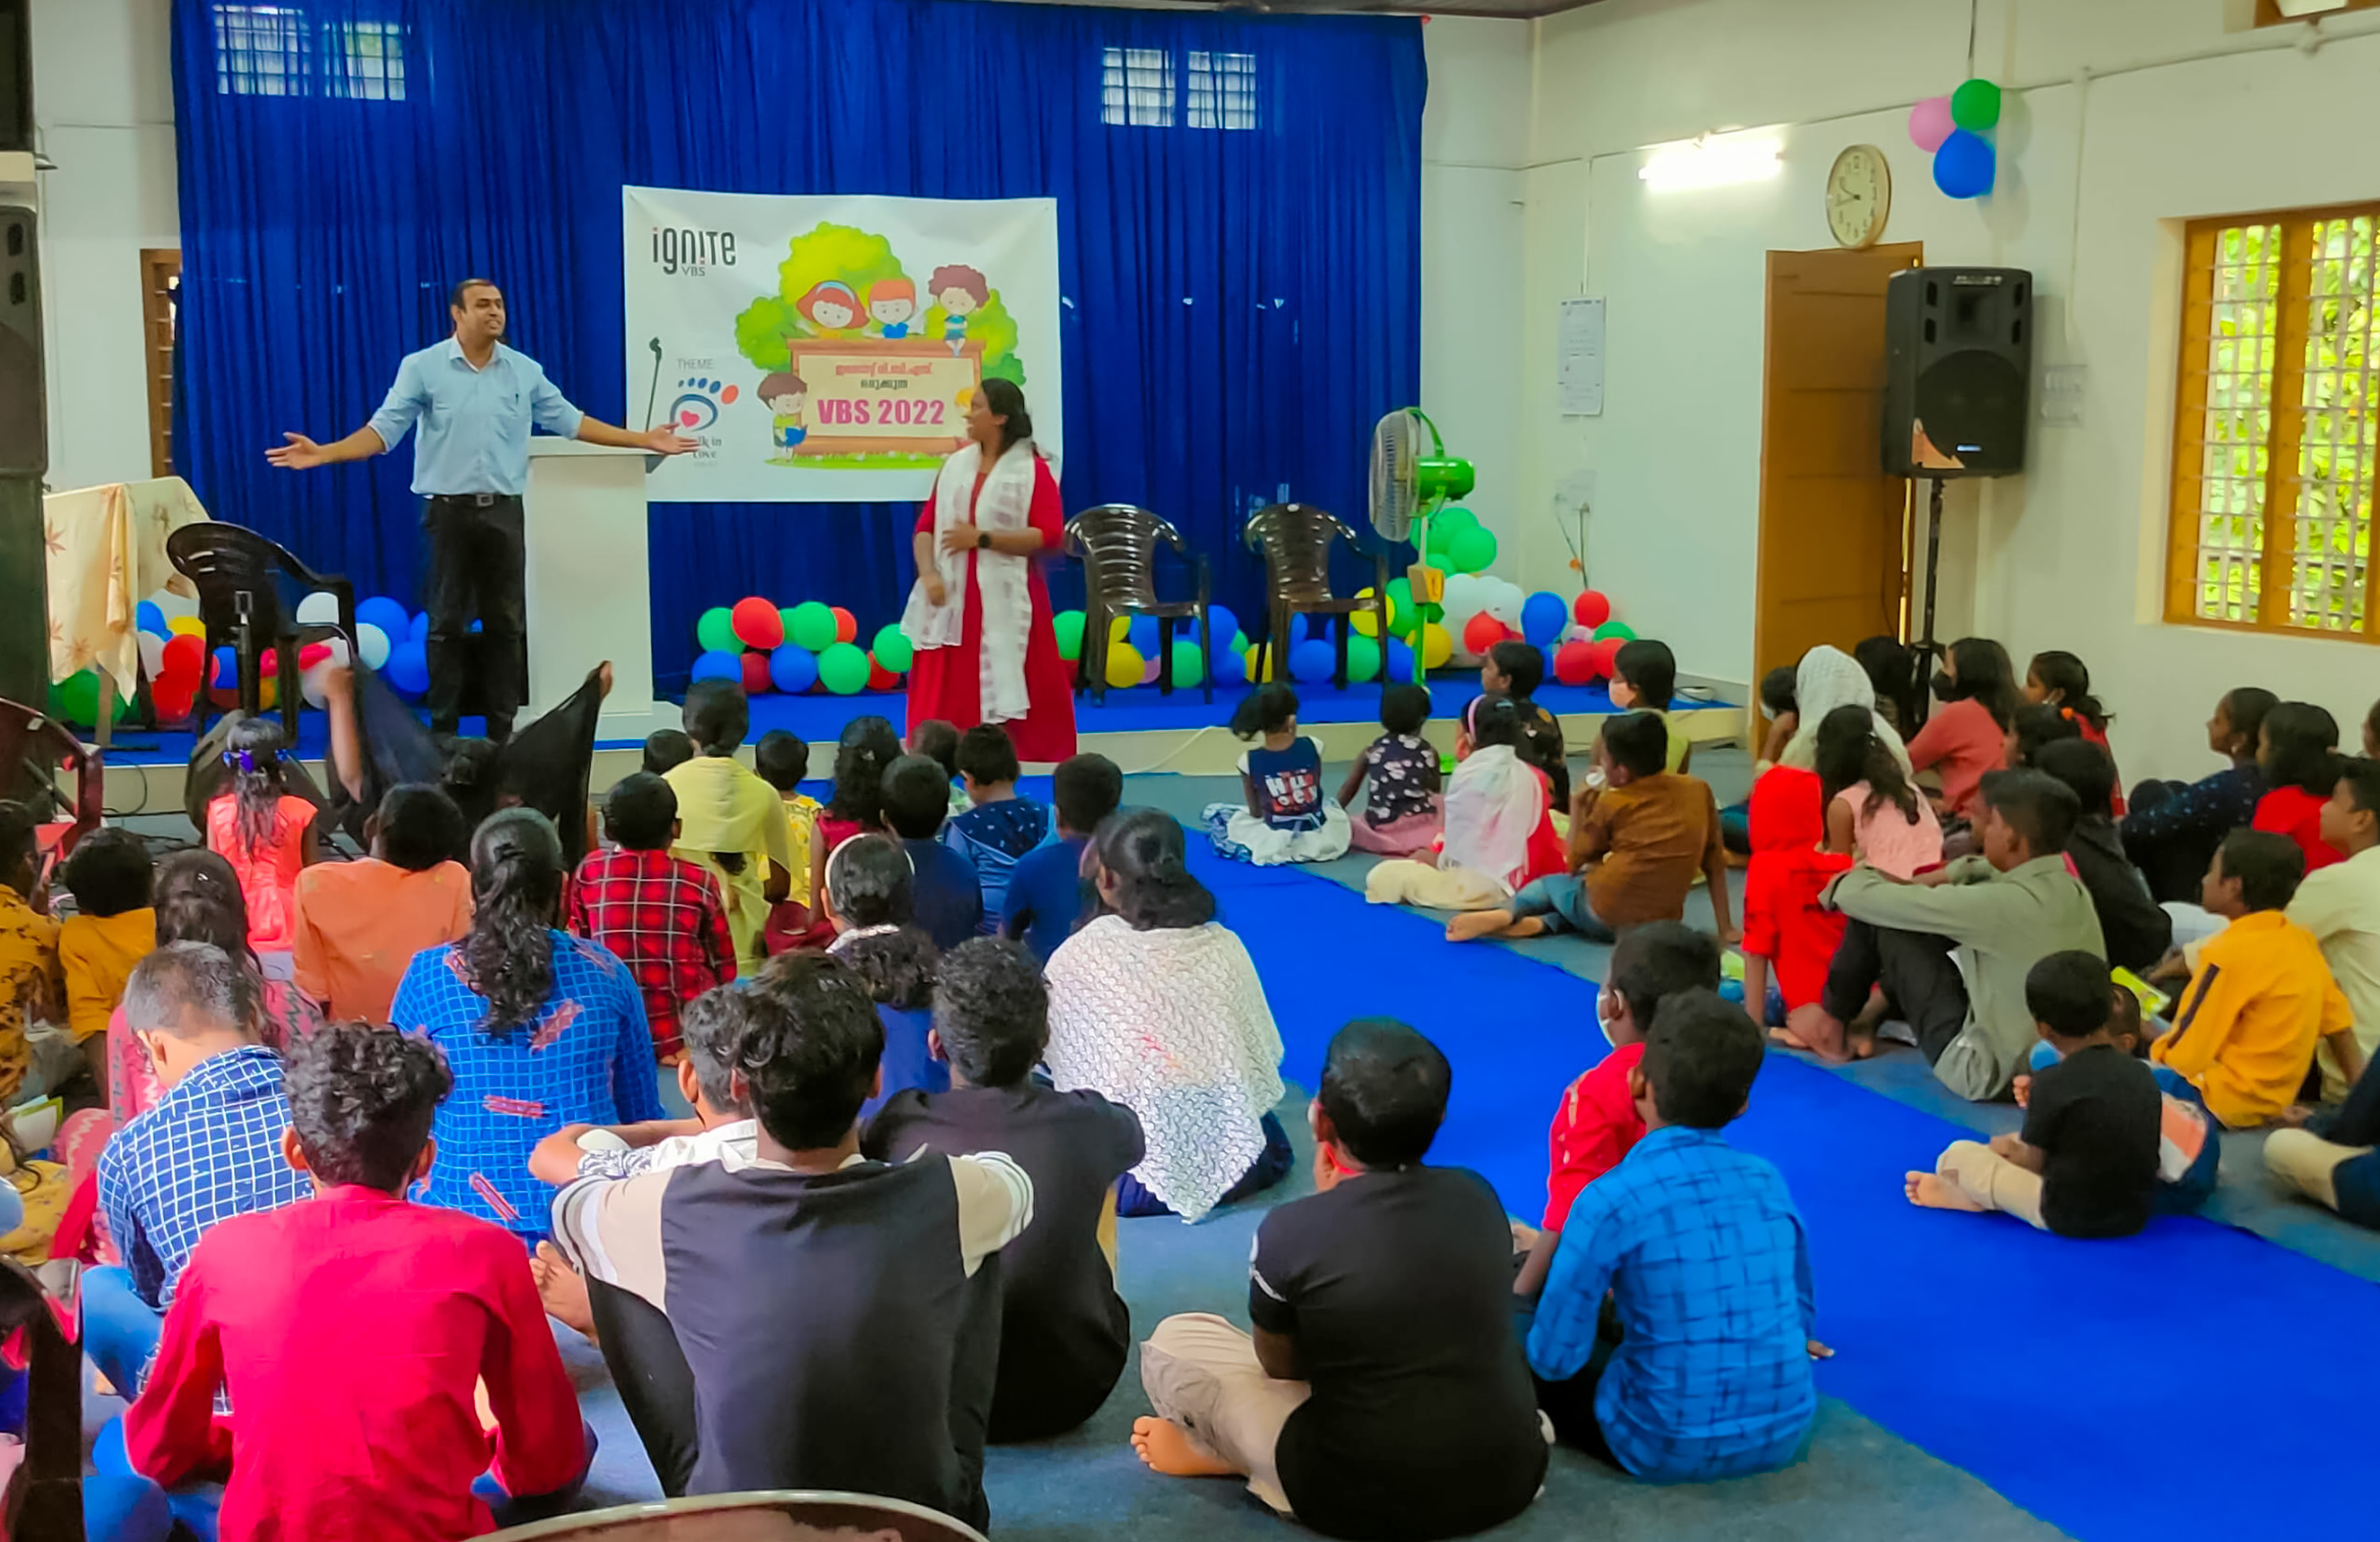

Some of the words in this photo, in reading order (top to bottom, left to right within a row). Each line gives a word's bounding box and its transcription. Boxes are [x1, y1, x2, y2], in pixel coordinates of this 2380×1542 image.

[681, 266, 705, 276] VBS
[676, 359, 715, 370] THEME
[817, 399, 870, 424] VBS
[877, 399, 945, 424] 2022
